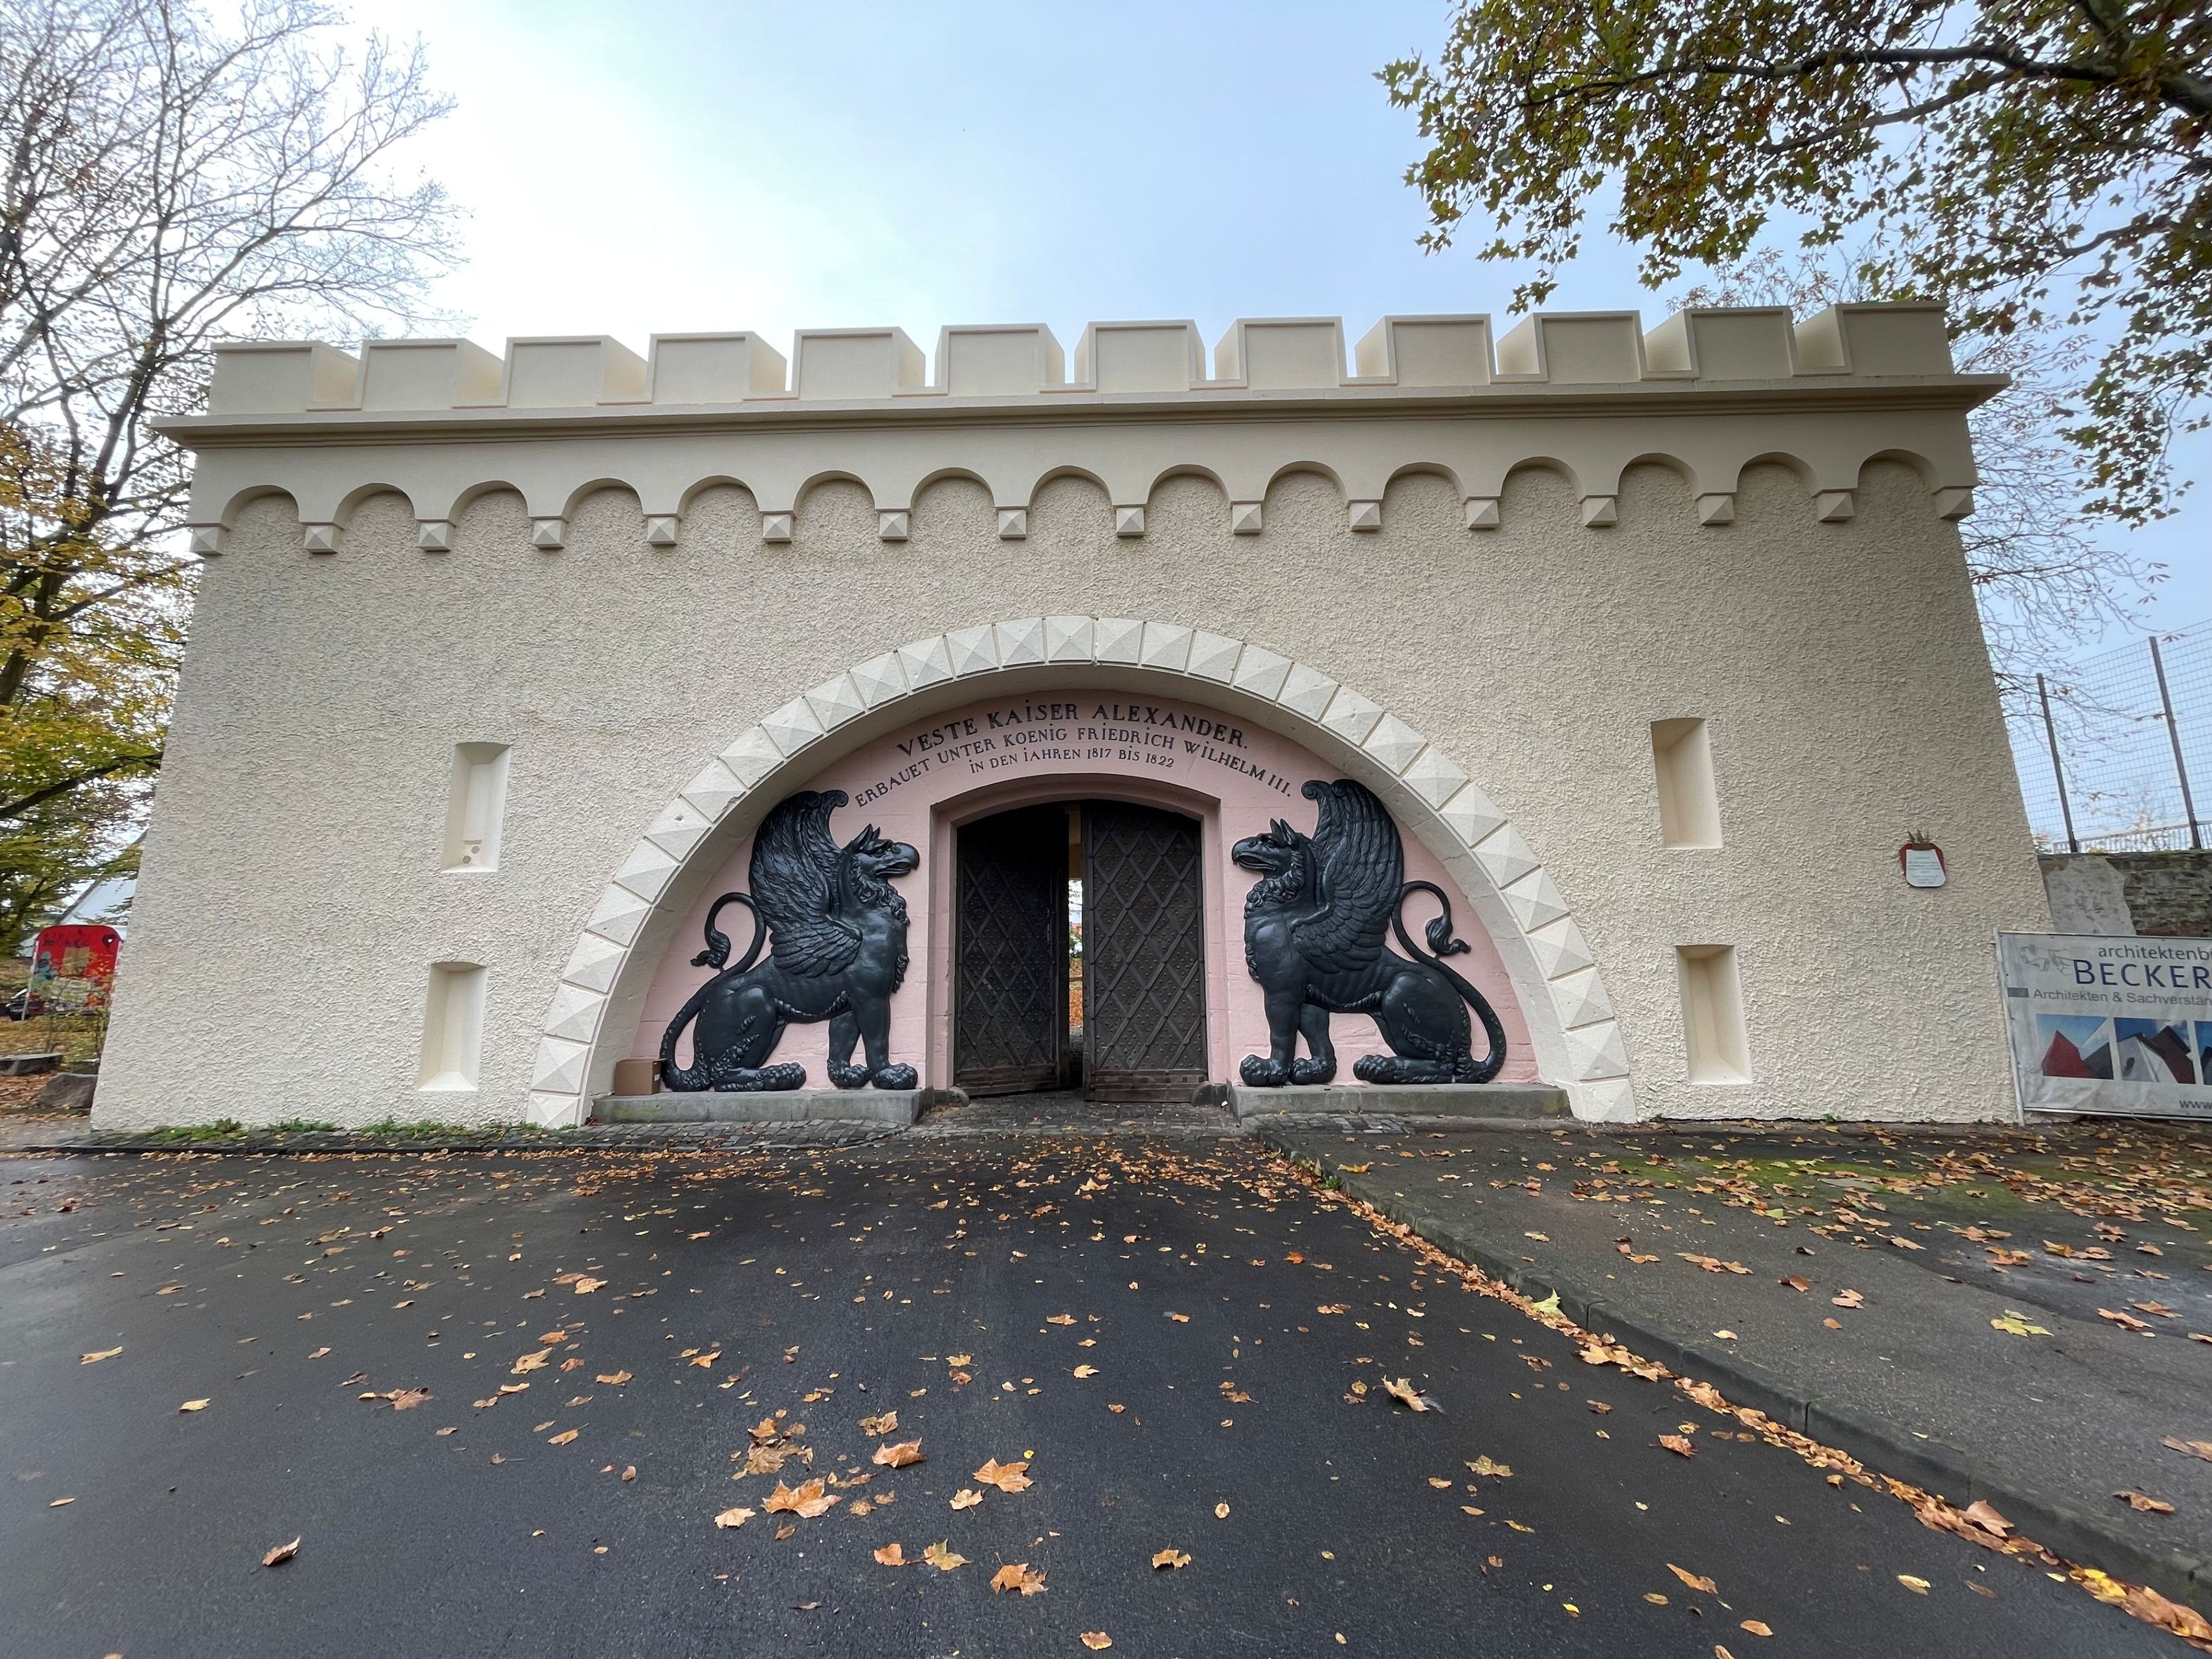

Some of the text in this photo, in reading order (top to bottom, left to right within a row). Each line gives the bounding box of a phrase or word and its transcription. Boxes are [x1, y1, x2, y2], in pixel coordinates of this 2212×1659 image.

[896, 718, 978, 756] VESTE
[1092, 704, 1247, 749] ALEXANDER.
[854, 758, 930, 807] ERBAUET
[937, 738, 997, 764] UNTER
[1077, 722, 1175, 749] FRIEDRICH
[1183, 740, 1267, 782] WILHELM
[989, 753, 1018, 768] DEN
[1086, 748, 1112, 759] 1817
[1118, 745, 1140, 762] BIS
[1145, 753, 1175, 768] 1822
[2099, 945, 2212, 960] architektenb
[2073, 959, 2212, 988] BECKER
[2033, 989, 2108, 1002] Architekten
[2112, 993, 2123, 1002] &
